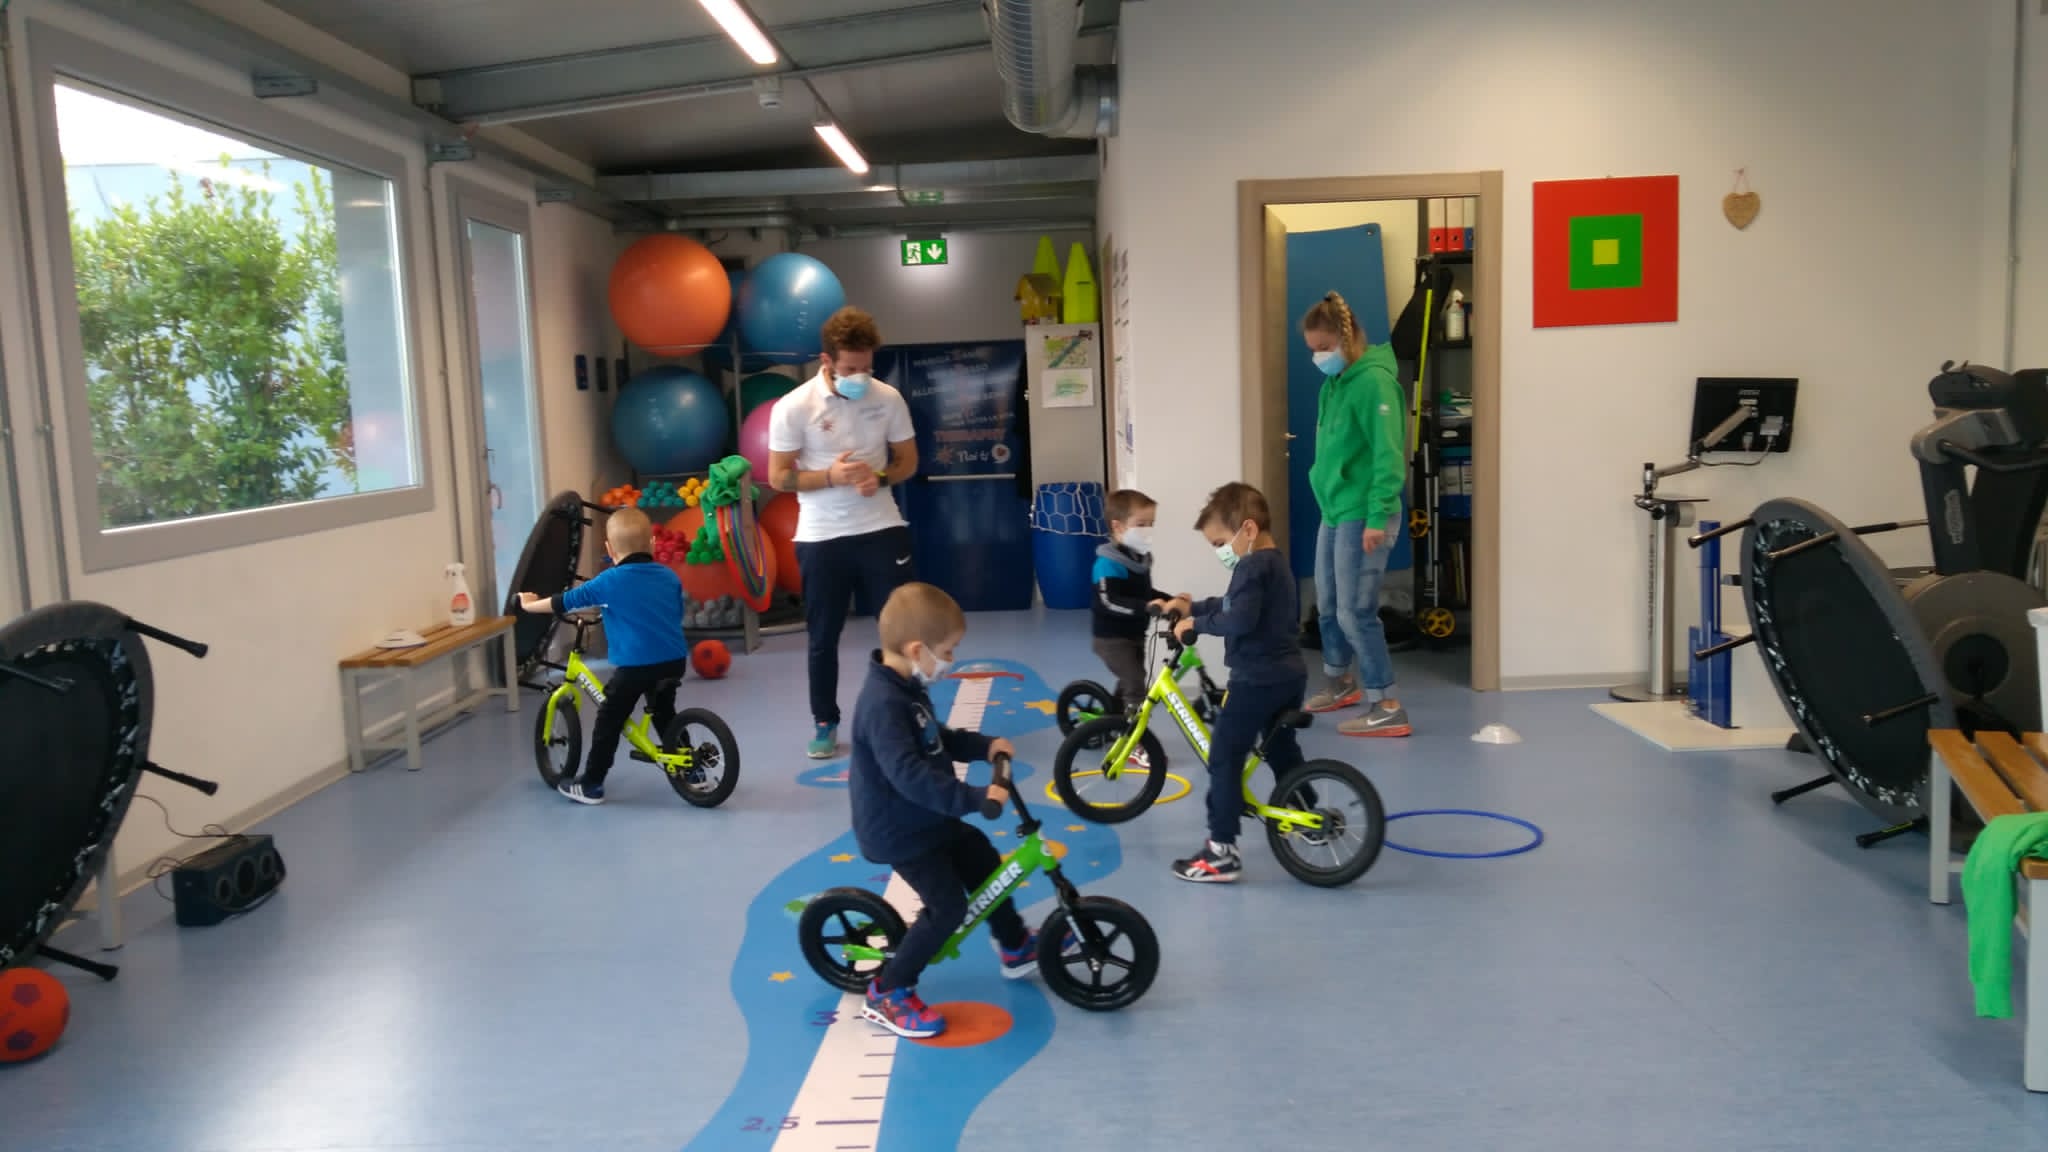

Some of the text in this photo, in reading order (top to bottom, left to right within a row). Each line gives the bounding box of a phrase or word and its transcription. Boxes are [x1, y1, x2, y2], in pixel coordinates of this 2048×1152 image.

[1167, 691, 1210, 751] STRIDER
[963, 861, 1023, 926] STRIDER
[810, 1011, 840, 1026] 3
[740, 1116, 800, 1133] 2,5
